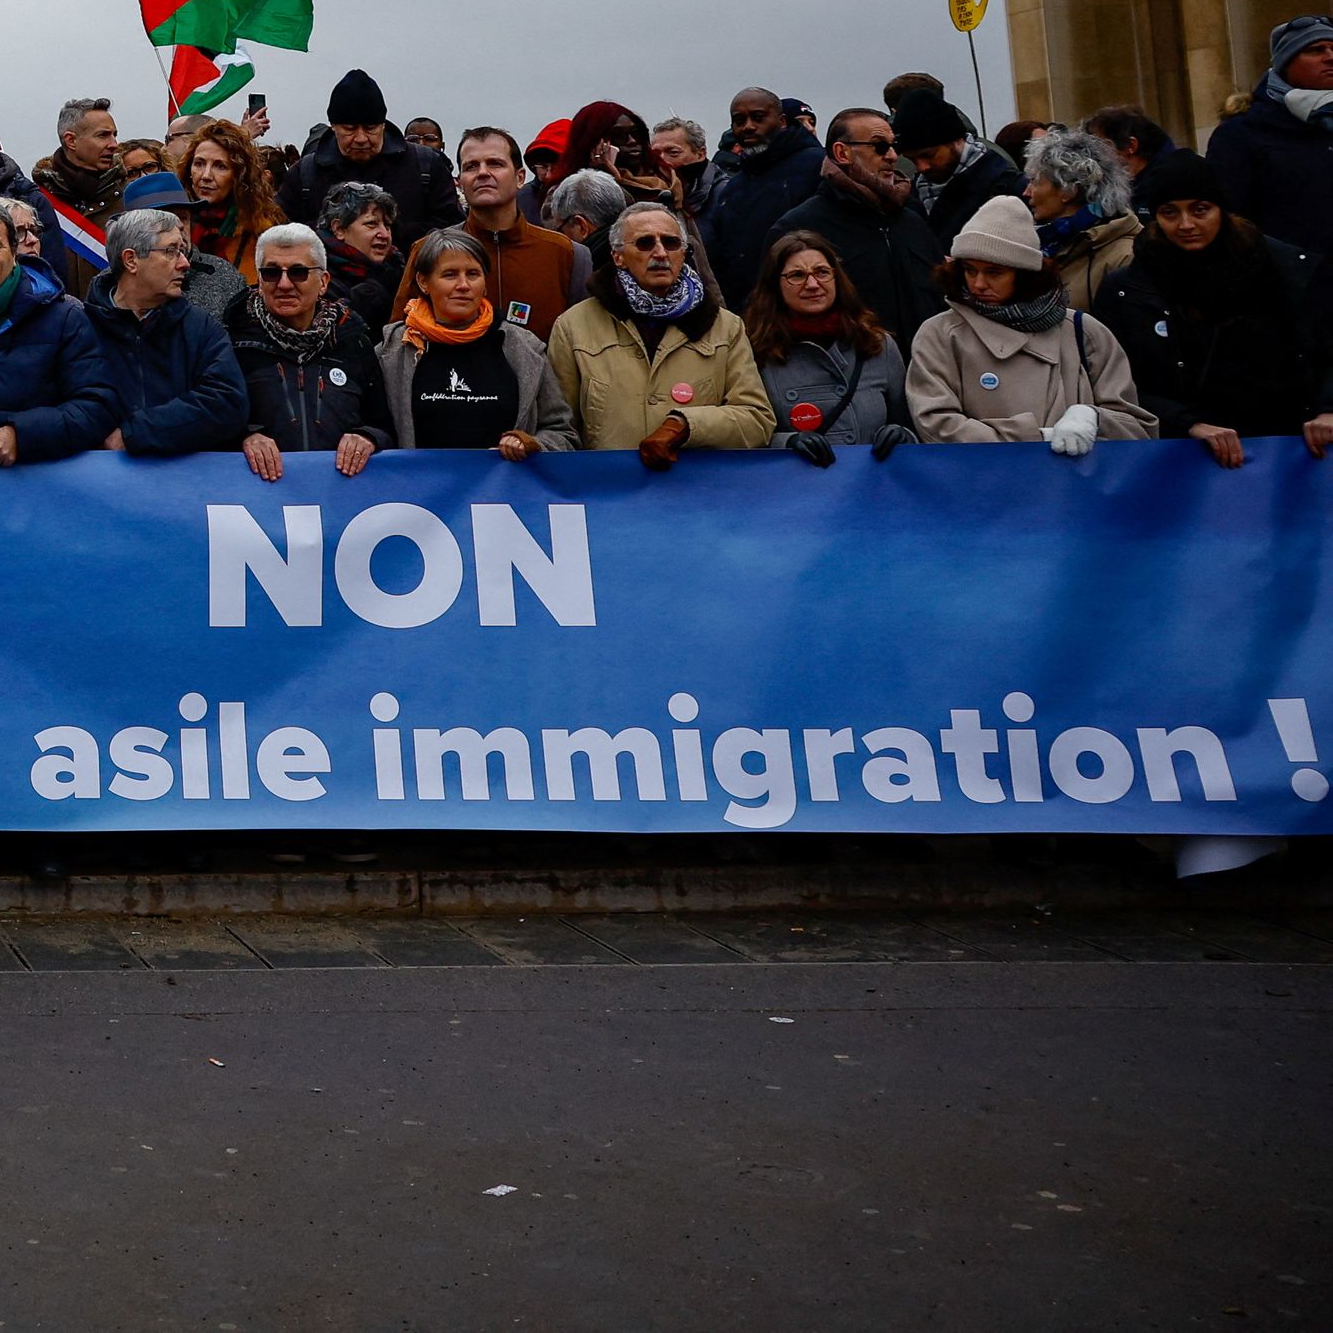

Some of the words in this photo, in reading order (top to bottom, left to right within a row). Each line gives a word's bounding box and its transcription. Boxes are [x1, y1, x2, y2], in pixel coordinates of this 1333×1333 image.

[467, 395, 498, 403] paysanne
[207, 502, 597, 629] NON
[30, 692, 332, 801] asile
[370, 691, 1237, 829] immigration
